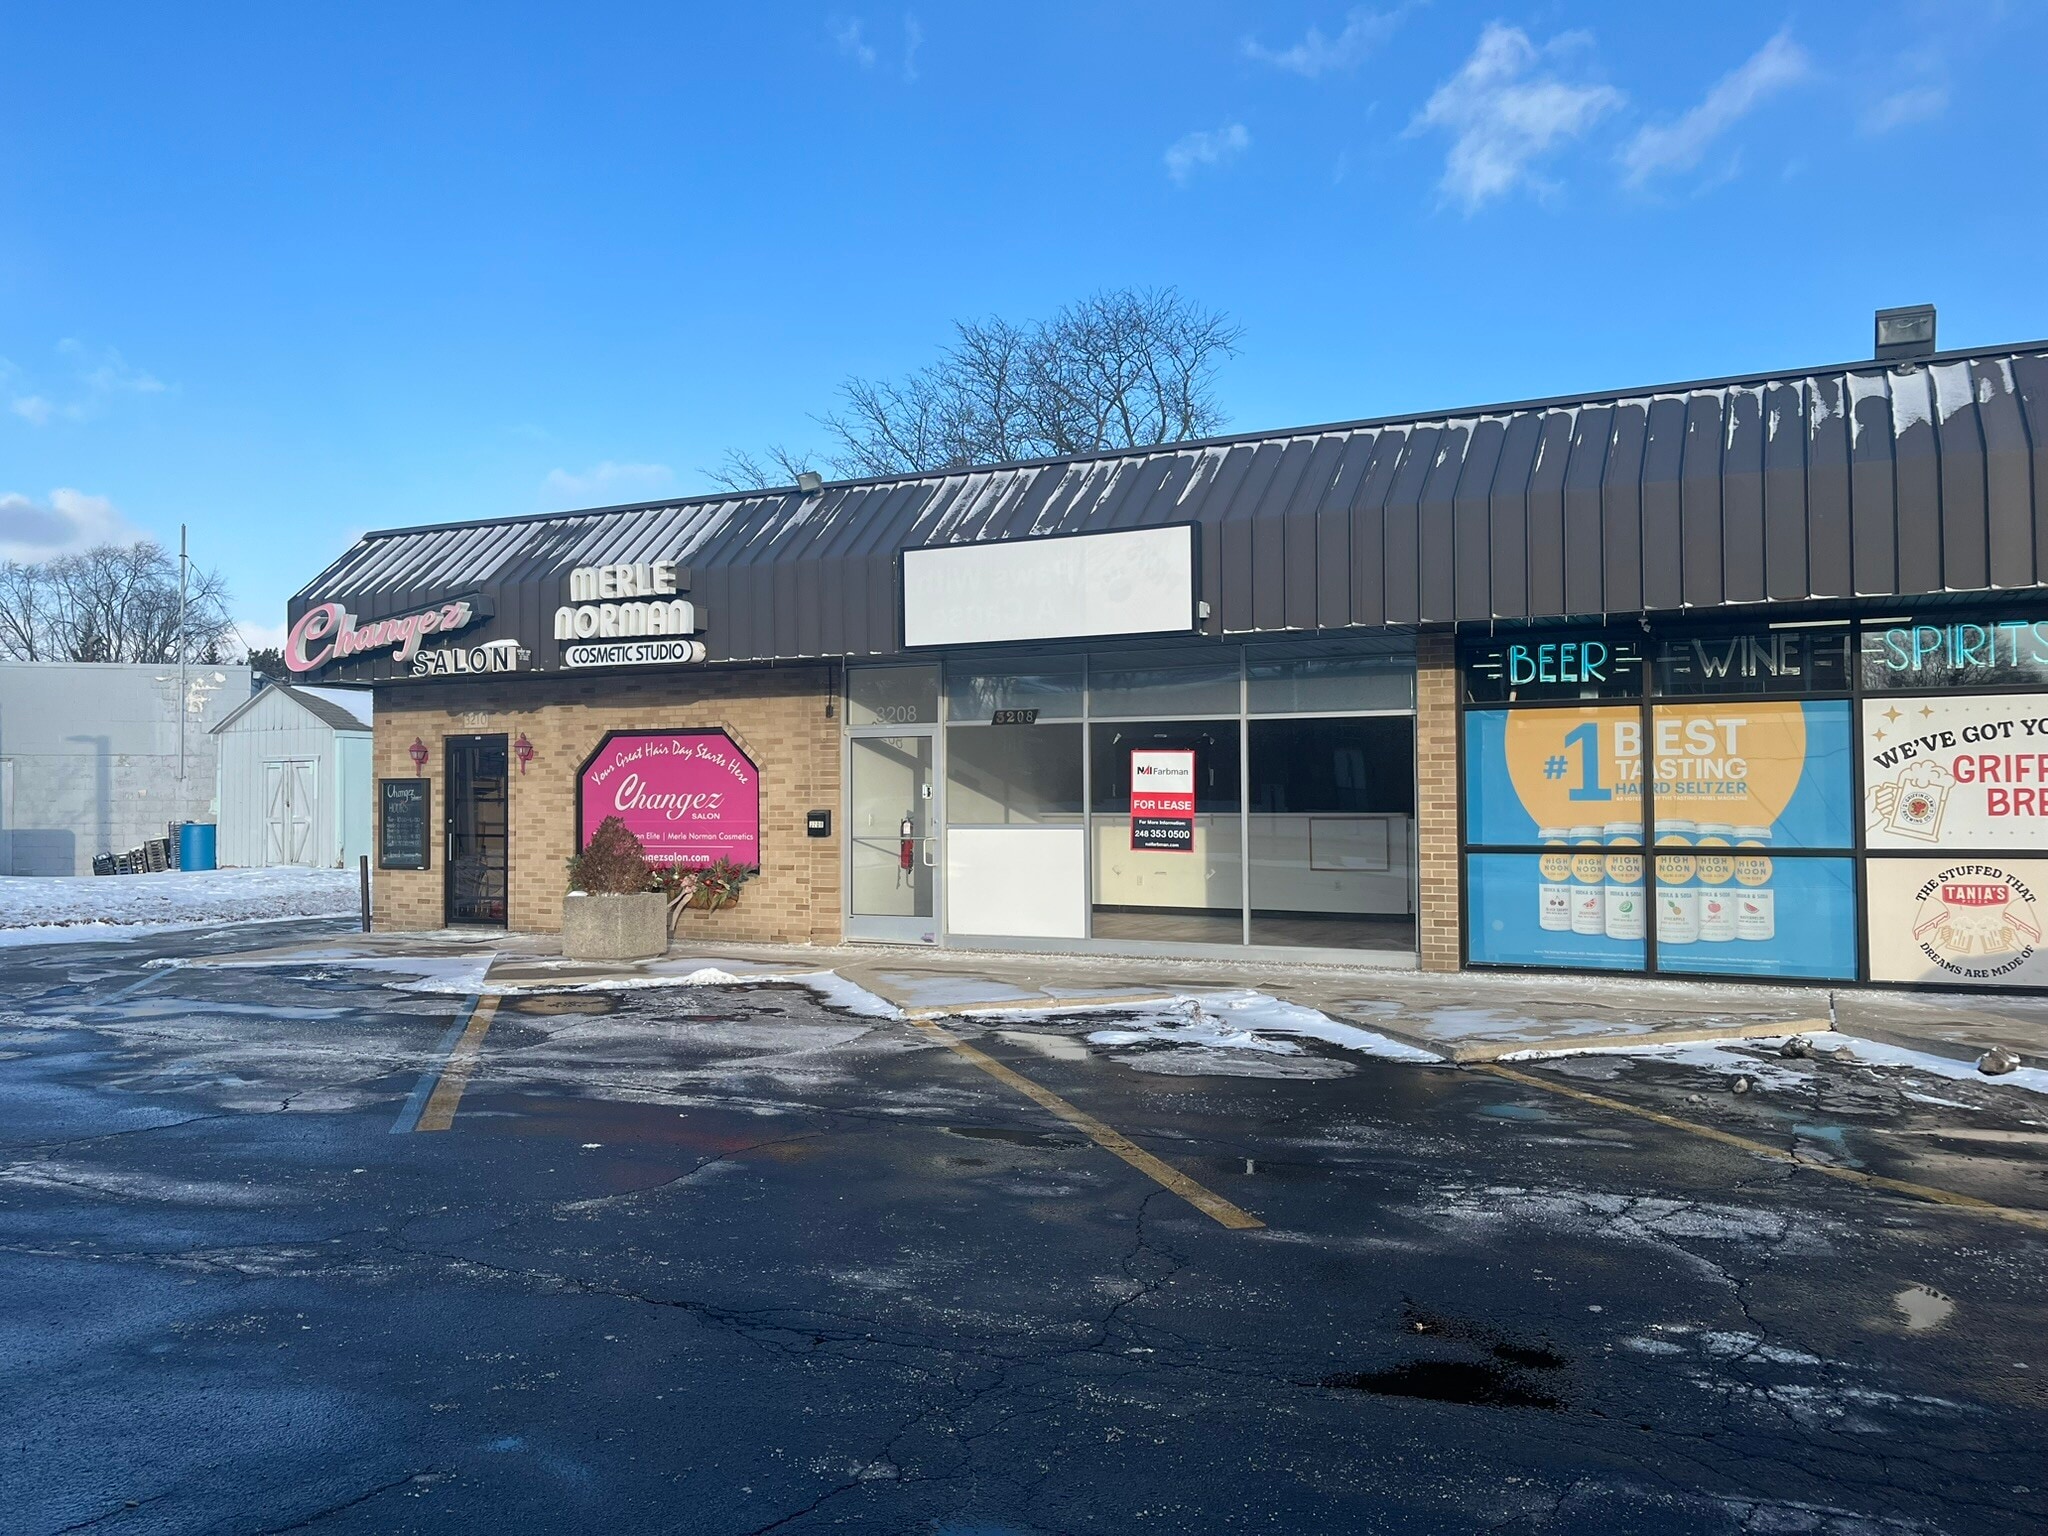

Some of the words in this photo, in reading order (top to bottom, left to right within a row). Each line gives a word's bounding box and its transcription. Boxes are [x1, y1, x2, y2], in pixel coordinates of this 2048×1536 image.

[570, 560, 677, 601] MERLE
[554, 599, 695, 640] NORMAN
[285, 602, 472, 673] Changez
[1885, 620, 2048, 671] SPIRITS
[412, 646, 515, 677] SALON
[572, 646, 632, 664] COSMETIC
[636, 643, 684, 661] STUDIO
[1510, 642, 1608, 685] BEER
[1692, 633, 1801, 678] WINE
[876, 705, 917, 722] 3208
[996, 711, 1034, 723] 3208
[1614, 718, 1747, 757] BEST
[1962, 720, 2014, 743] GOT
[591, 764, 615, 786] Your
[615, 747, 643, 767] Great
[645, 742, 669, 757] Hair
[672, 740, 692, 760] Day
[696, 743, 726, 767] Starts
[727, 758, 749, 785] Here
[1153, 767, 1189, 776] Farbman
[1614, 757, 1748, 780] TASTING
[614, 773, 725, 821] Changez
[1615, 782, 1671, 794] HARD
[1675, 781, 1747, 794] SELTZER
[1134, 800, 1155, 809] FOR
[1158, 801, 1192, 810] LEASE
[646, 832, 661, 840] Elite
[667, 832, 687, 840] Merle
[689, 832, 717, 840] Norman
[718, 832, 754, 841] Cosmetics
[1135, 830, 1149, 838] 248
[1150, 829, 1166, 838] 353
[1167, 830, 1190, 839] 0500
[1916, 879, 1939, 902] THE
[1938, 865, 2003, 883] STUFFED
[2006, 874, 2036, 903] THAT
[1946, 886, 2006, 900] TANIA'S
[1920, 942, 1962, 975] DREAMS
[1964, 969, 1989, 978] ARE
[1991, 957, 2024, 977] MADE
[2021, 944, 2034, 959] OF
